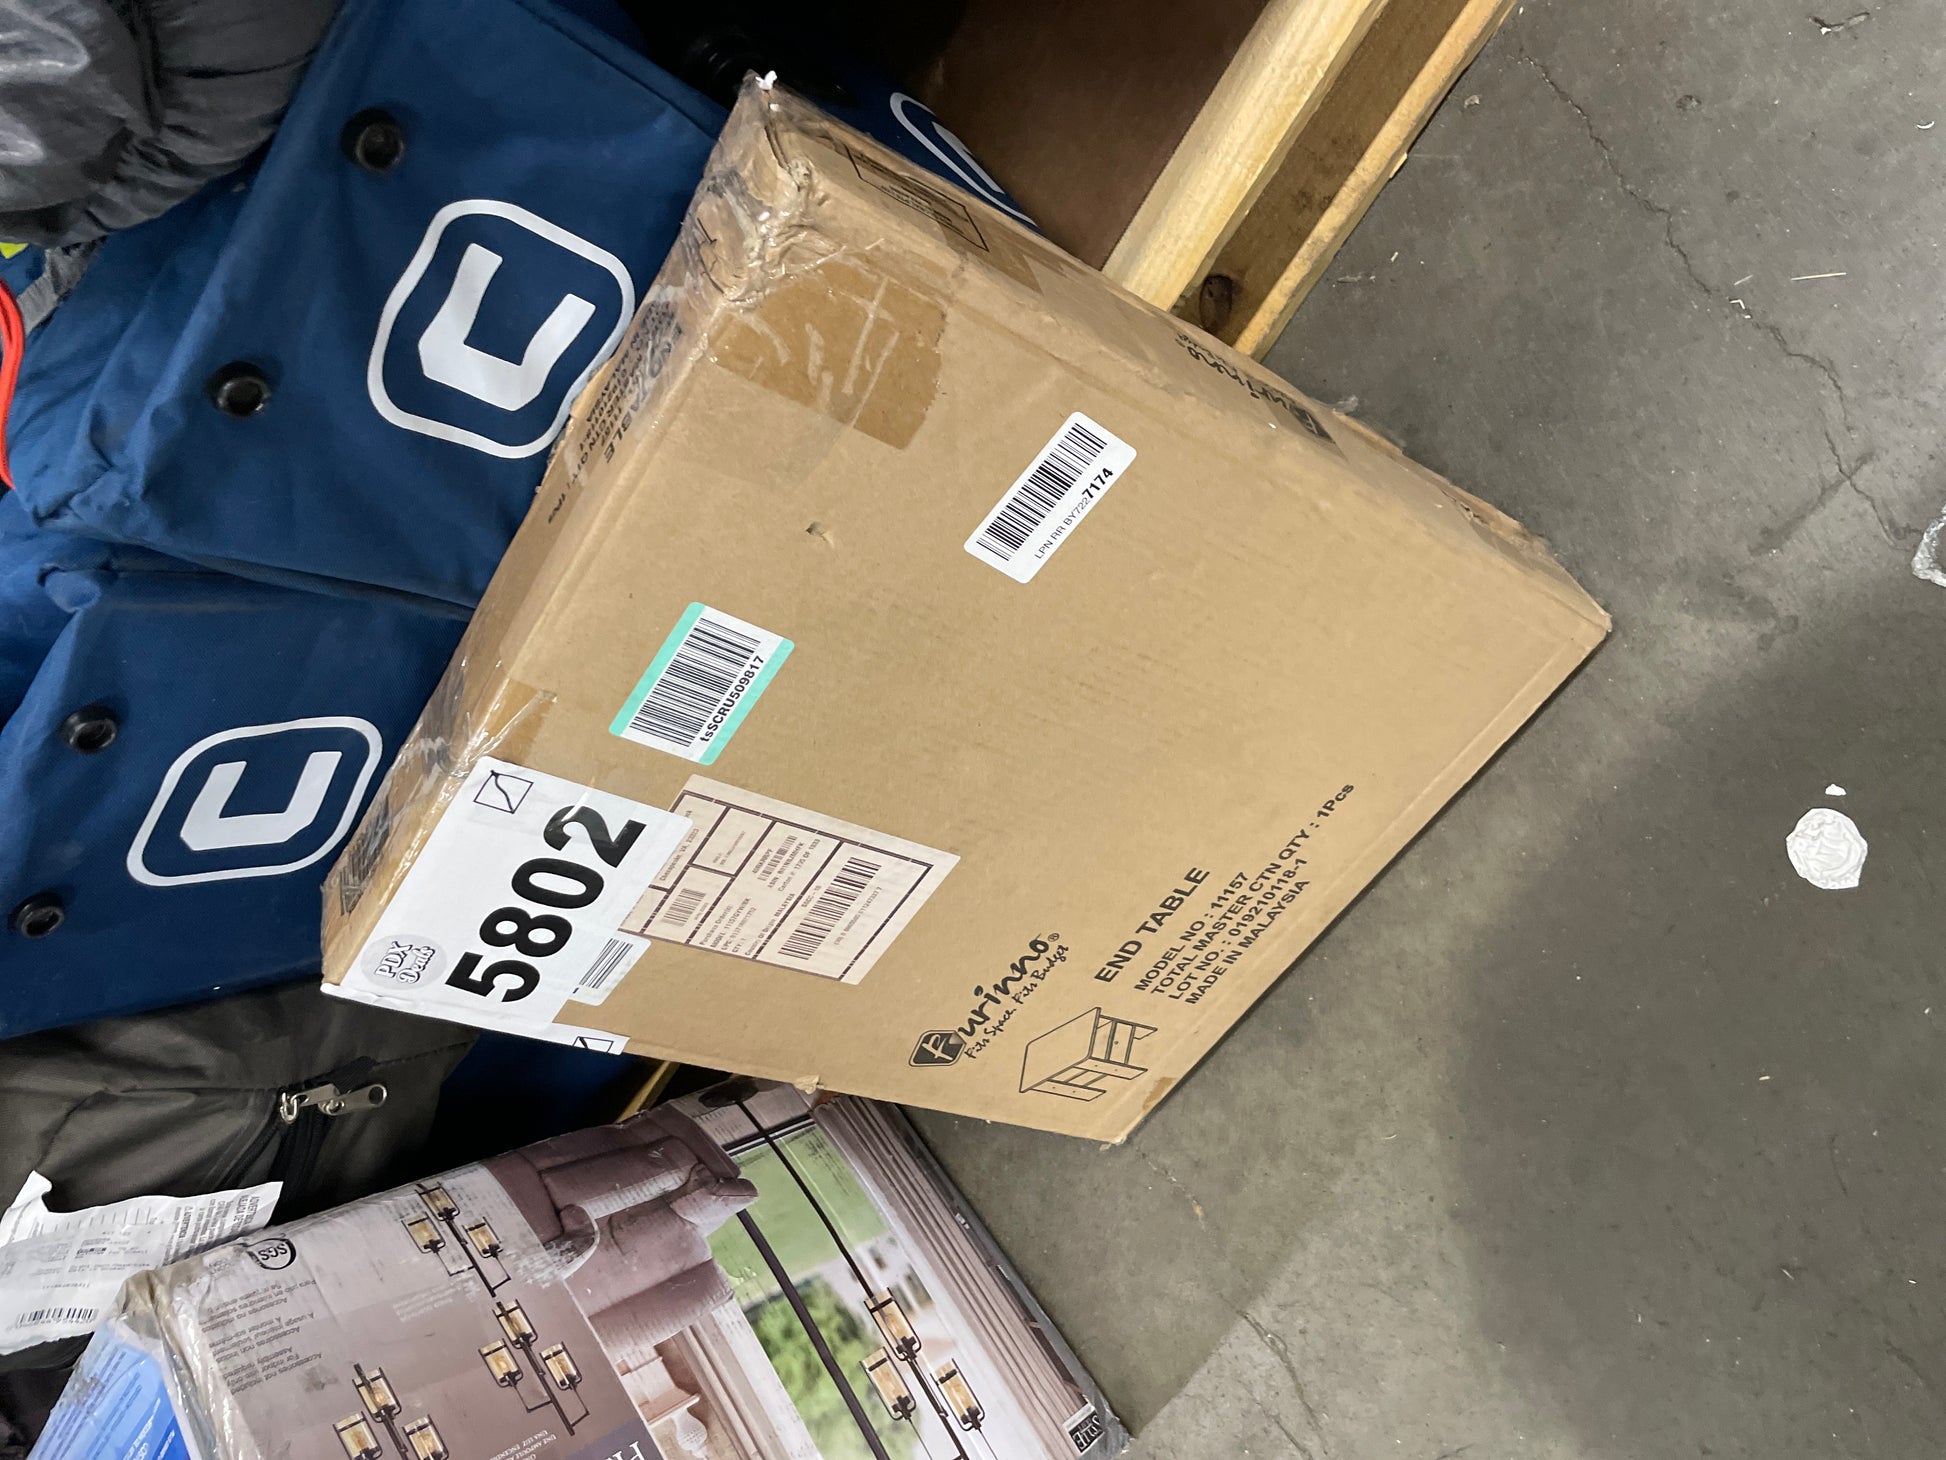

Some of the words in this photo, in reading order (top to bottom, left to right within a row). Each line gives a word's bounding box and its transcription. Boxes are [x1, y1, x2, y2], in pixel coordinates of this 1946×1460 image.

[1034, 540, 1053, 559] LPN
[1050, 525, 1066, 540] RR
[700, 655, 764, 742] tsSCRU509817
[445, 805, 647, 1003] 5802
[774, 893, 796, 917] MALAYSIA
[1150, 954, 1198, 994] TOTAL
[1192, 894, 1253, 951] MASTER
[1249, 862, 1282, 892] CTN
[1278, 829, 1310, 860] QTY
[1094, 940, 1143, 983] END
[1135, 867, 1210, 934] TABLE
[1134, 945, 1186, 991] MODEL
[1180, 920, 1206, 941] NO
[1211, 872, 1248, 909] 11157
[1168, 972, 1199, 1000] LOT
[1228, 858, 1307, 937] 019210118-1
[1185, 966, 1228, 1004] MADE
[1222, 946, 1244, 964] IN
[1239, 880, 1310, 946] MALAYSIA
[376, 940, 413, 978] PDX
[397, 945, 436, 984] Deals
[964, 1039, 990, 1059] Fits
[1011, 982, 1038, 1004] Fits
[1030, 945, 1069, 980] Budget
[258, 1243, 288, 1261] SGS
[285, 1316, 306, 1327] usage
[240, 1344, 255, 1353] non
[257, 1346, 293, 1364] Assembly
[278, 1352, 322, 1374] Accessories
[286, 1353, 300, 1362] For
[264, 1371, 278, 1381] not
[522, 1437, 534, 1447] LUZ
[534, 1430, 549, 1440] UNA
